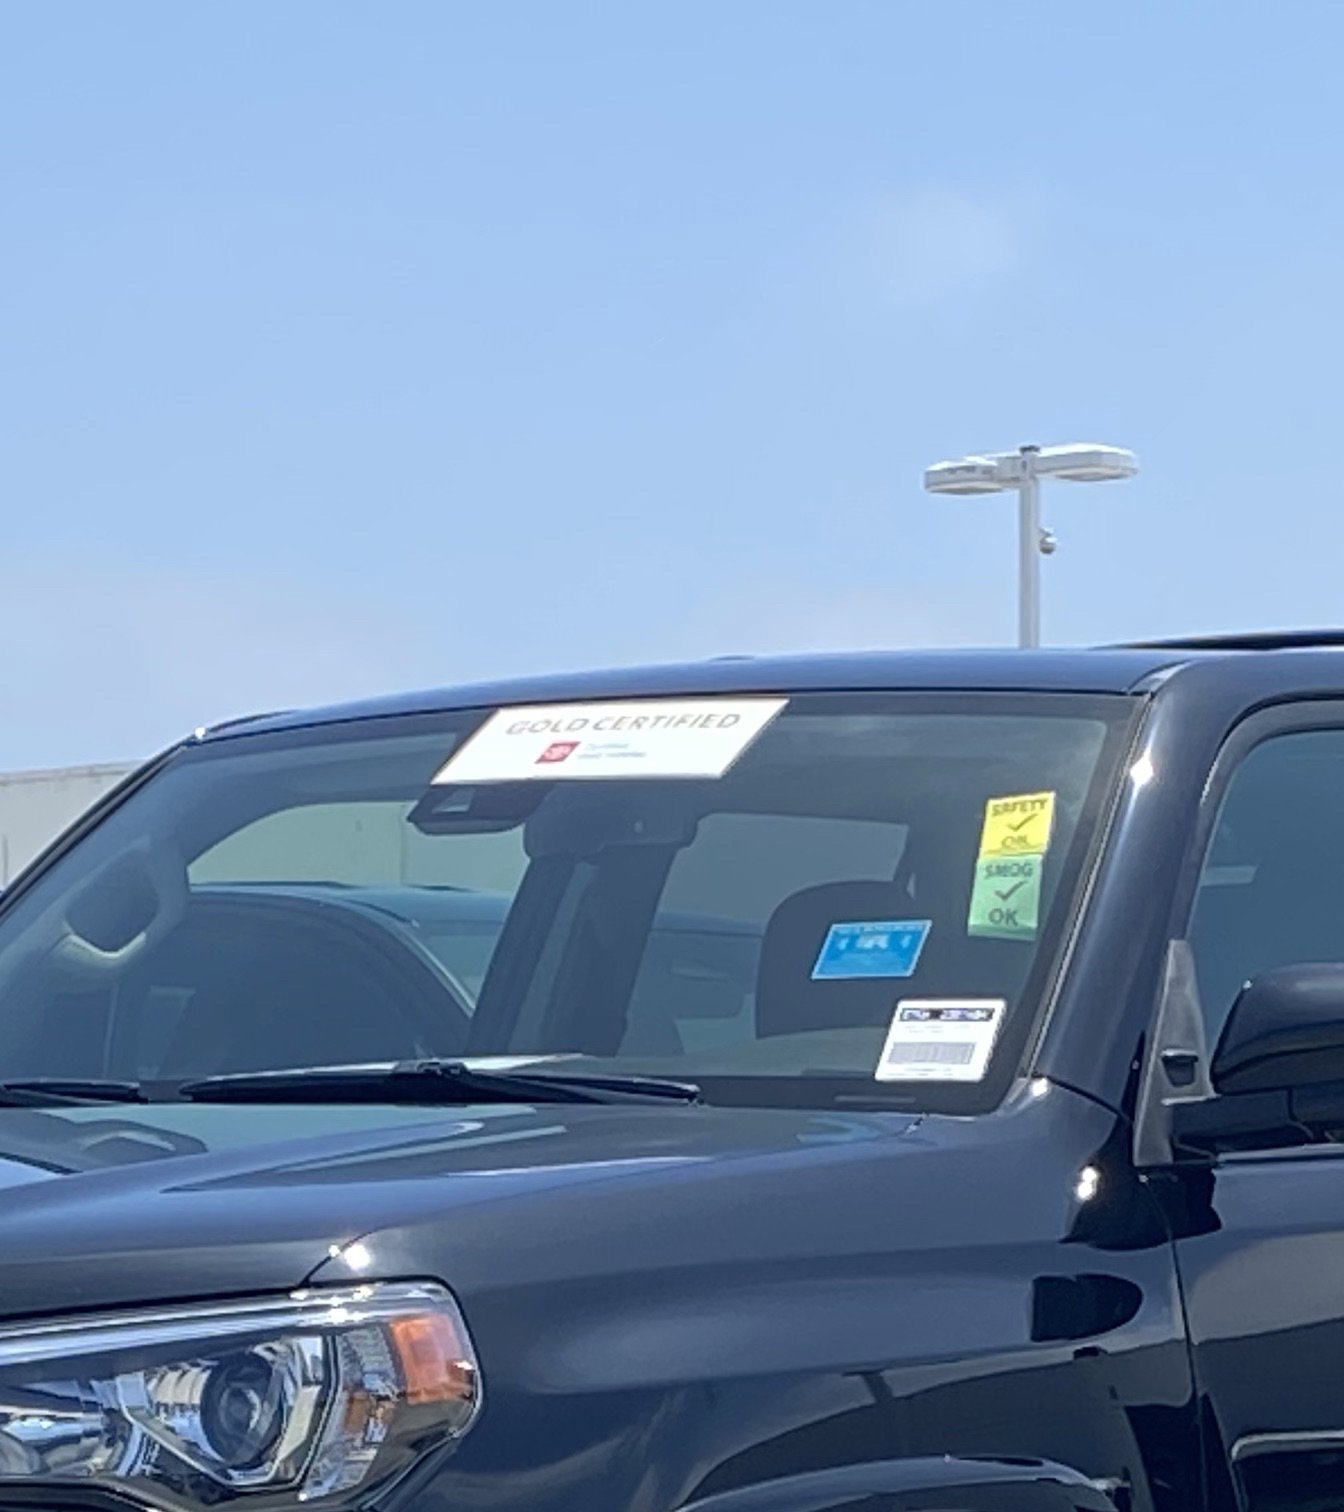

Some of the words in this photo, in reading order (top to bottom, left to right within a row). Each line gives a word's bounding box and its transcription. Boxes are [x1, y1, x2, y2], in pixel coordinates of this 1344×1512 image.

[506, 717, 589, 735] GOLD
[592, 713, 741, 731] CERTIFIED
[992, 799, 1048, 817] SAFETY
[1001, 835, 1030, 849] OK
[985, 863, 1033, 880] SMOG
[988, 908, 1018, 926] OK
